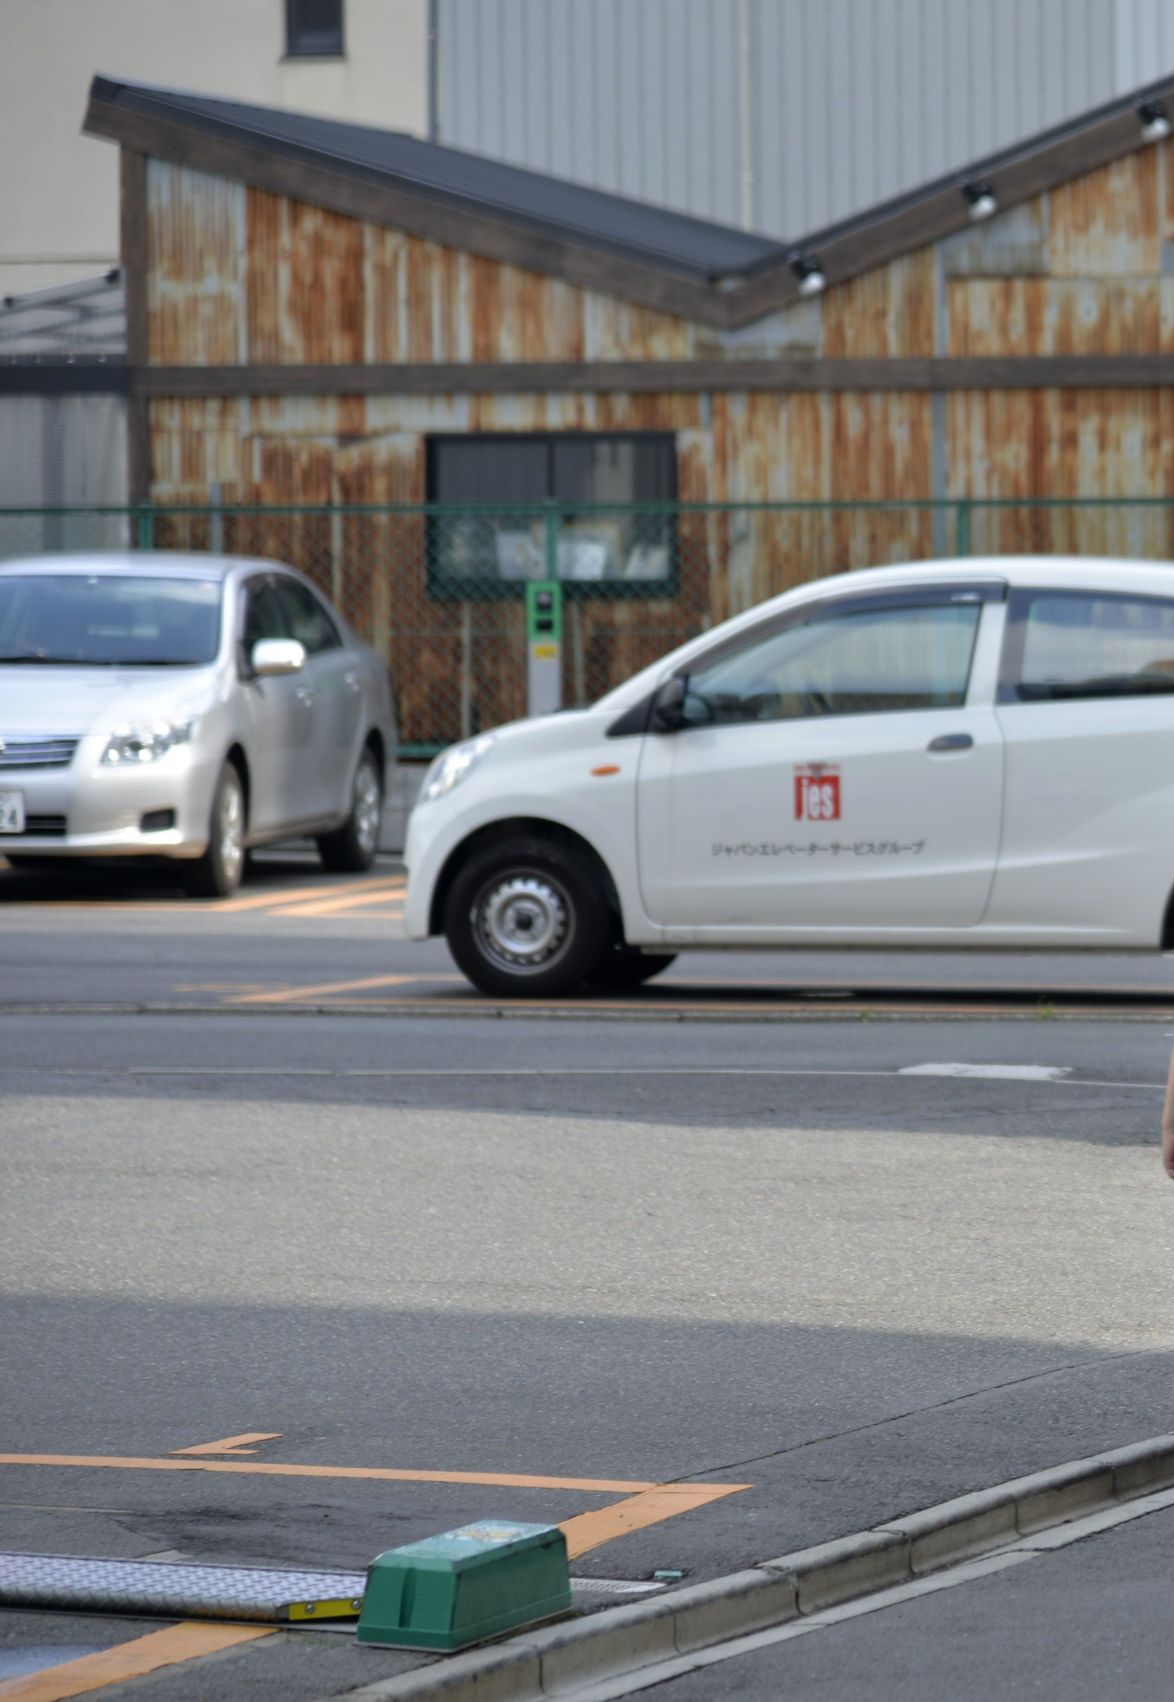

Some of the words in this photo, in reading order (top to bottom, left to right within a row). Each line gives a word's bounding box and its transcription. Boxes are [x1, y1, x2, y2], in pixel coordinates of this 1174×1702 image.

[712, 839, 925, 856] ジャパンエレベーターサービスグループ
